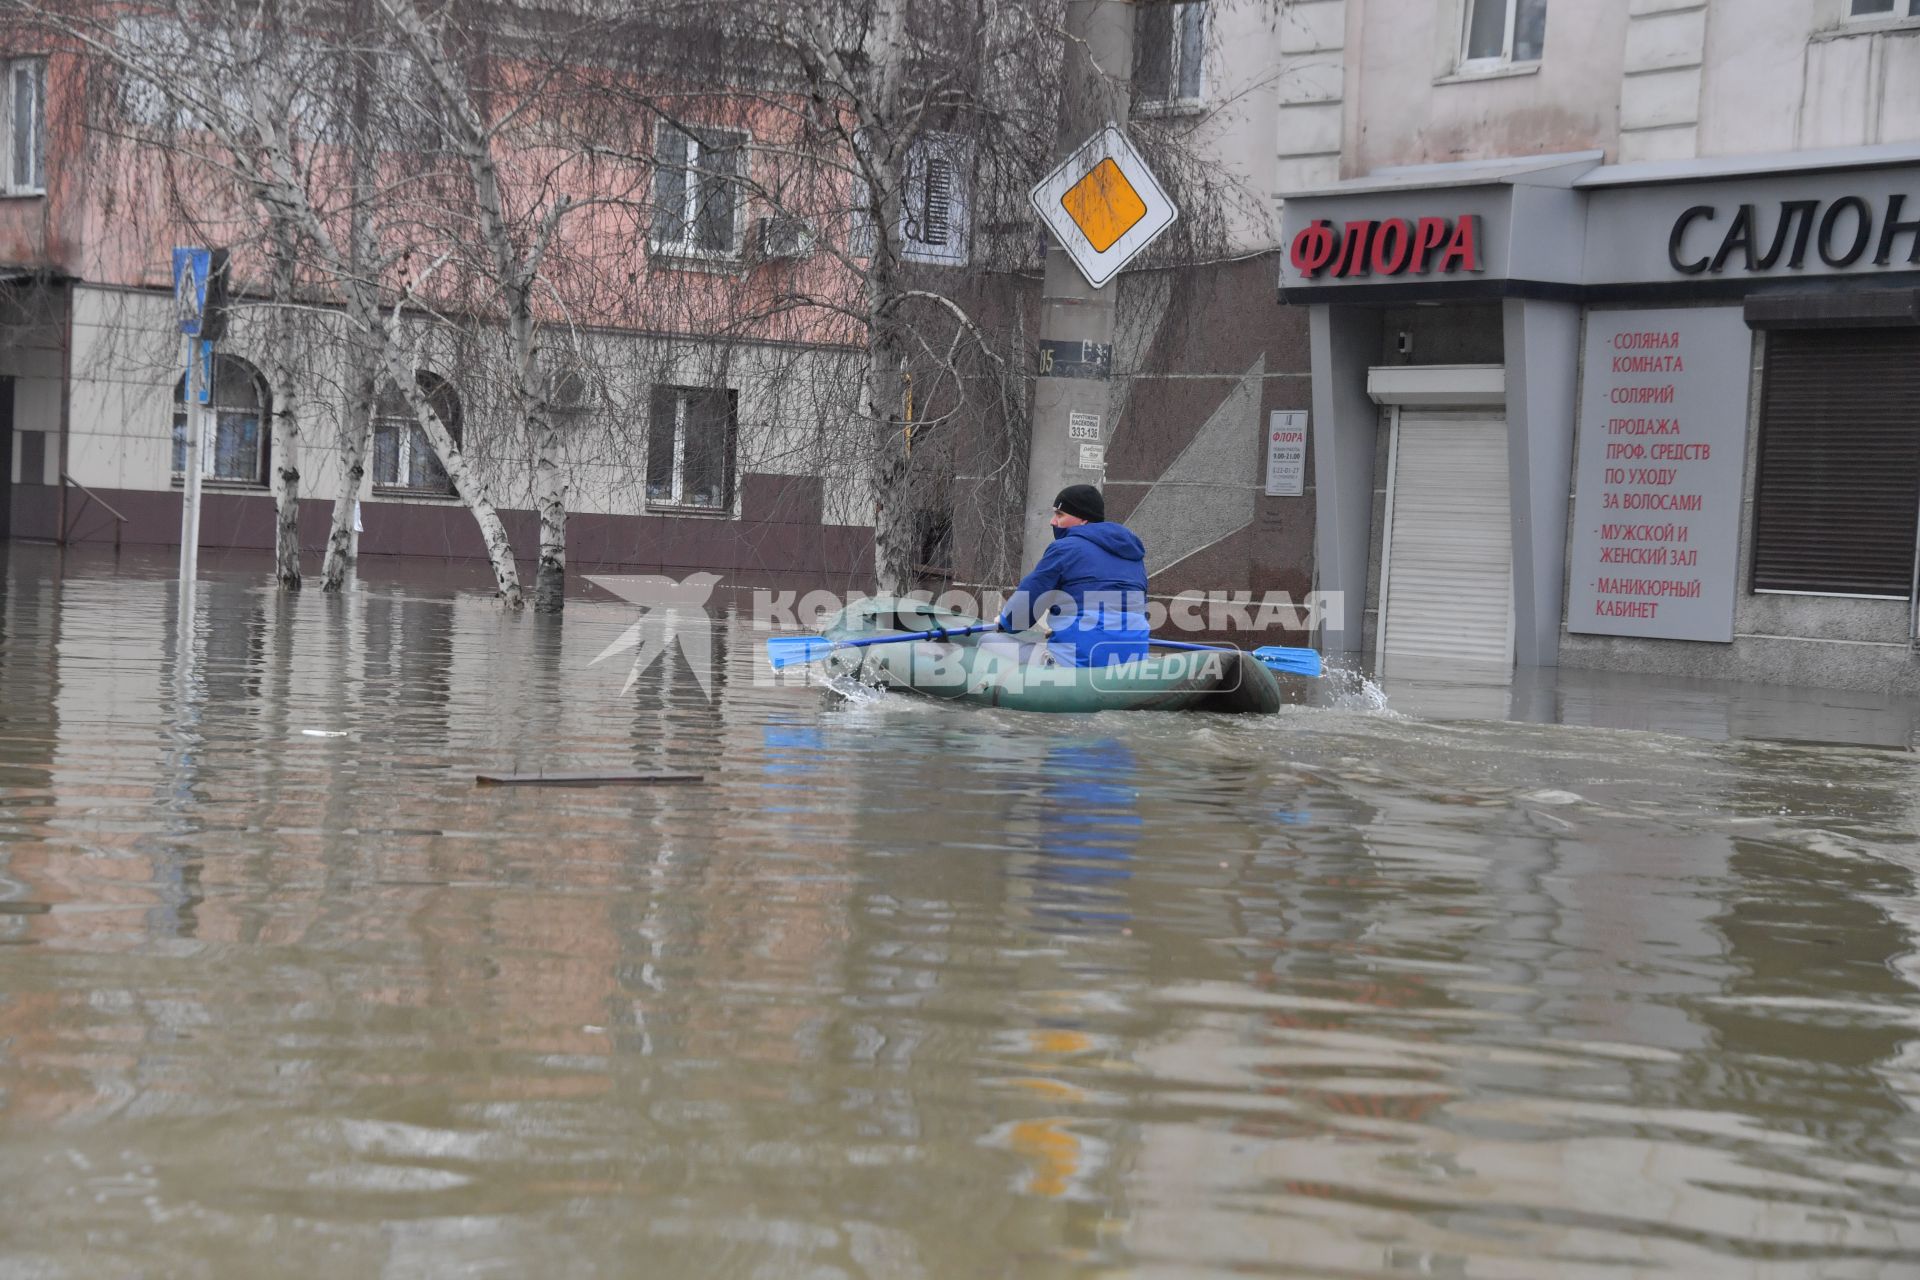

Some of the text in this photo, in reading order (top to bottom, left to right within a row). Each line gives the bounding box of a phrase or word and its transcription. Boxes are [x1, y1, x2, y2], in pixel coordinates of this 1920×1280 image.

[1668, 194, 1920, 275] САЛОН
[1290, 214, 1483, 278] ФЛОРА
[1614, 332, 1679, 349] СОЛЯНАЯ
[1612, 356, 1684, 373] КОМНАТА
[1610, 384, 1674, 403] СОЛЯРИЙ
[1608, 418, 1680, 435] ПРОДАЖА
[1272, 432, 1302, 443] ФЛОРА
[1606, 443, 1711, 461] ПРОФ. СРЕДСТВ
[1604, 468, 1677, 485] ПО УХОДУ
[1602, 493, 1702, 511] ЗА ВОЛОСАМИ
[1601, 522, 1689, 542] МУЖСКОЙ И
[1600, 546, 1697, 566] ЖЕНСКИЙ ЗАЛ
[1597, 577, 1702, 598] МАНИКЮРНЫЙ
[1596, 600, 1659, 619] КАБИНЕТ
